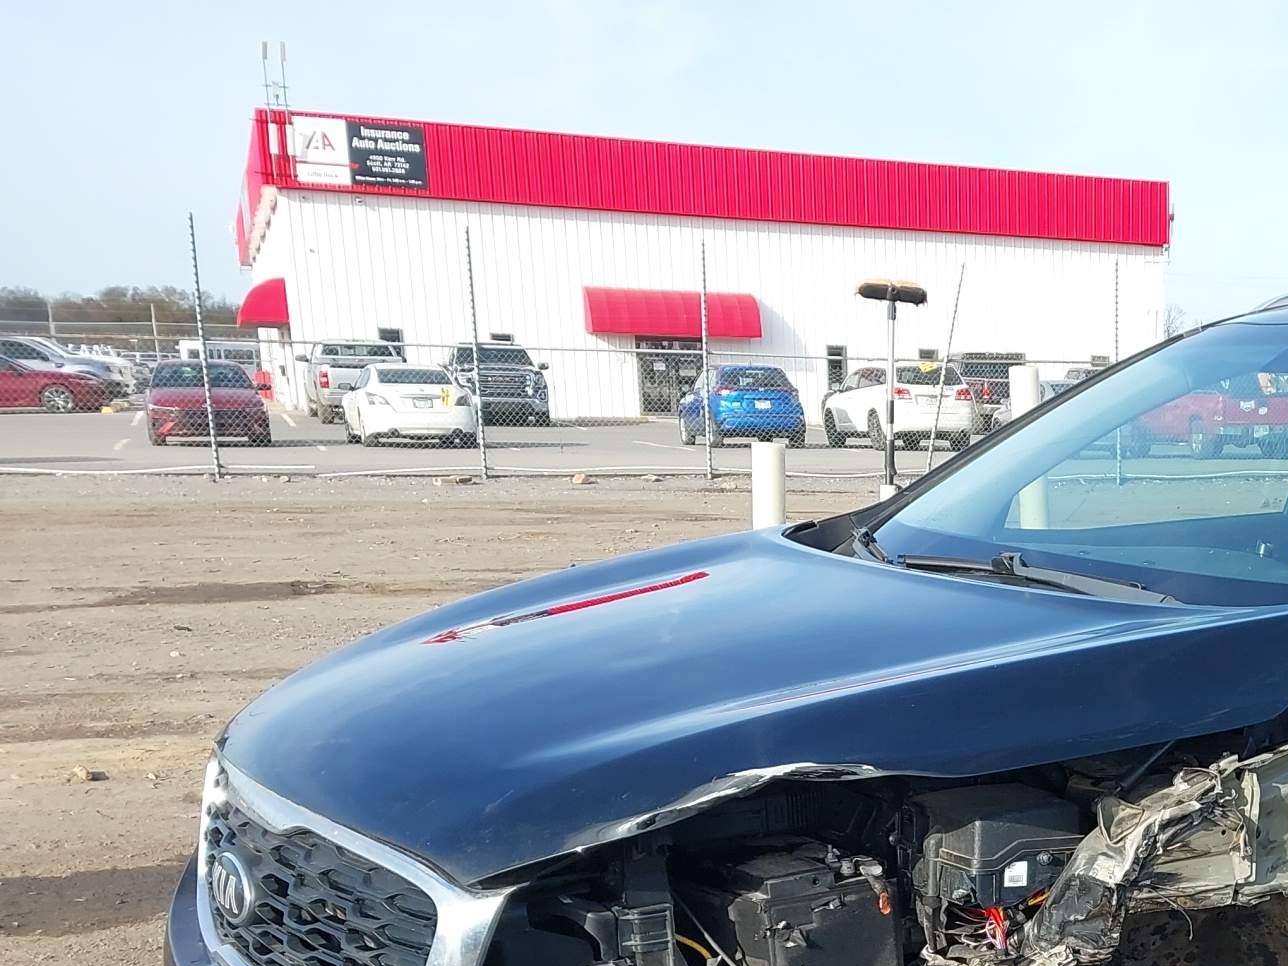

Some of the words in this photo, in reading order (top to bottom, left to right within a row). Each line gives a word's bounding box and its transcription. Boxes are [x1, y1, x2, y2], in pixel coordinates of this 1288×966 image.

[360, 126, 410, 140] Insurance
[351, 136, 375, 149] Auto
[377, 138, 421, 152] Auctions
[212, 861, 239, 914] KIA
